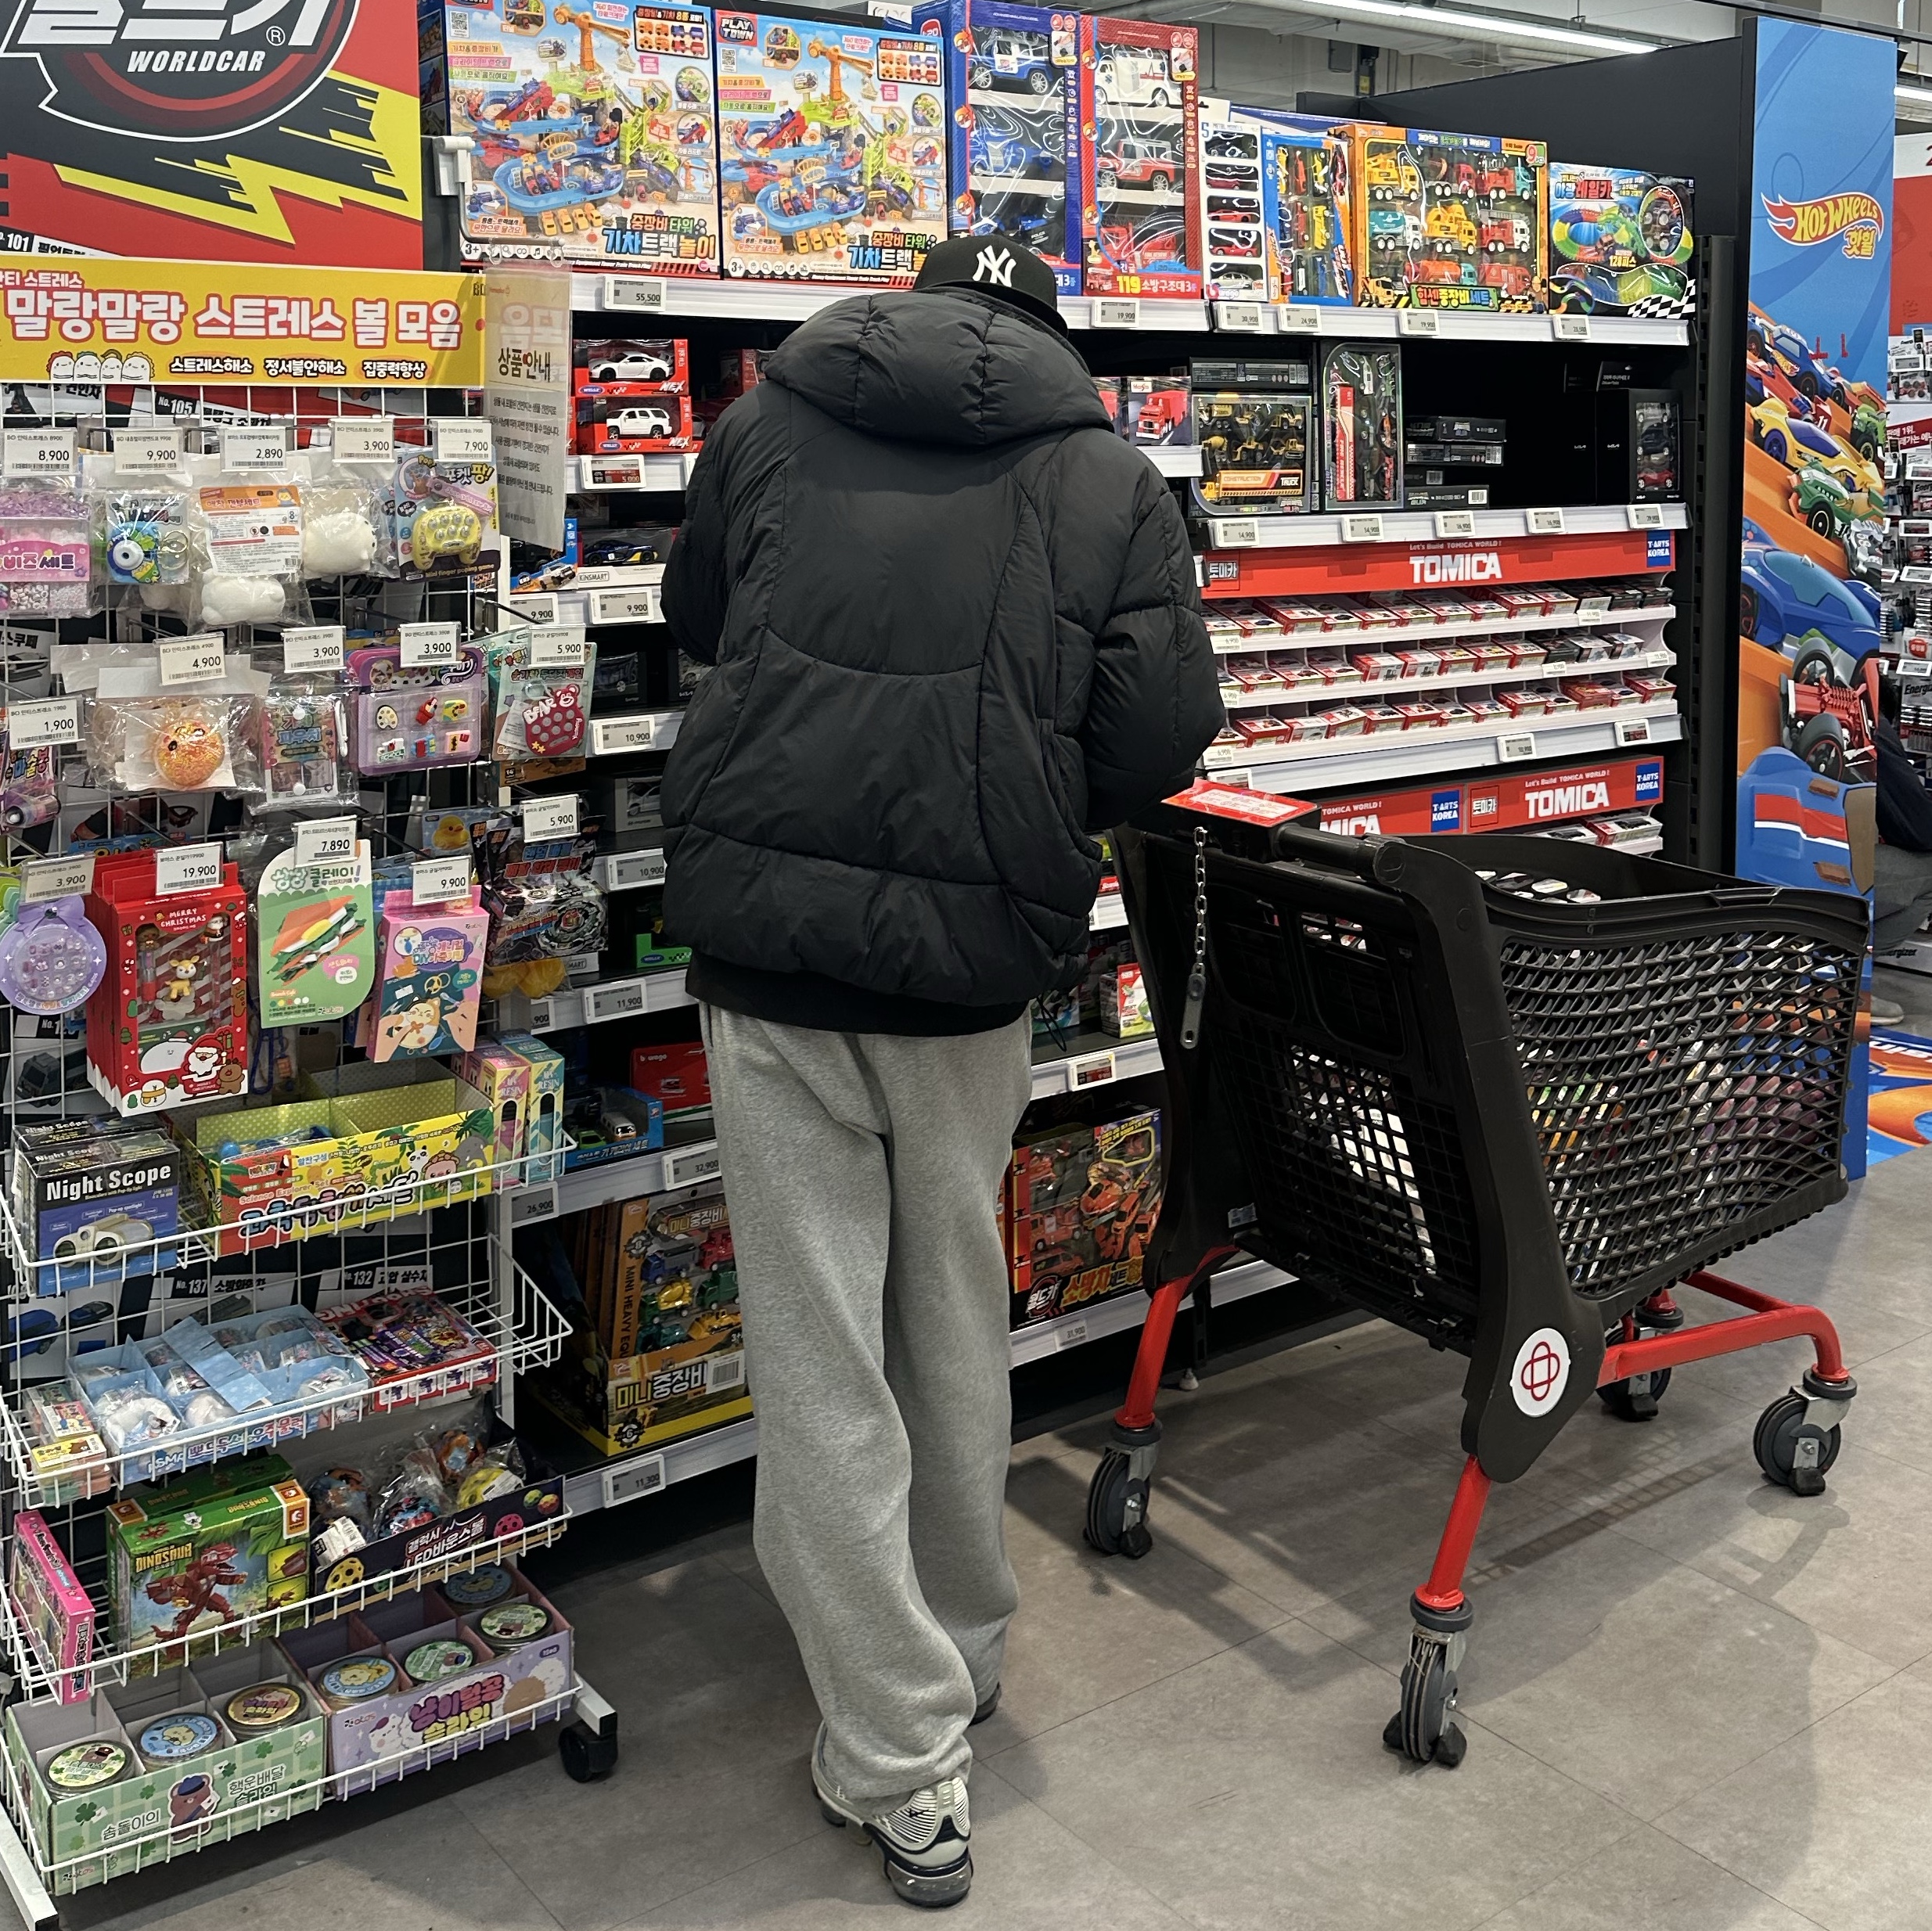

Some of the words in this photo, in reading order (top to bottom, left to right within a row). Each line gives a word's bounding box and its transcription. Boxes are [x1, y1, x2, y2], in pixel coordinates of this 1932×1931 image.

[721, 18, 751, 30] PLAY
[723, 28, 754, 41] TOWN
[127, 50, 265, 73] WORLDCAR
[7, 233, 30, 252] 101
[1848, 228, 1875, 257] 핫휠
[731, 261, 744, 271] 3+
[972, 245, 1016, 286] NY
[24, 271, 83, 289] 스트레스
[1117, 275, 1141, 293] 119
[636, 293, 660, 302] 55,500
[6, 290, 186, 342] 말랑말랑
[196, 294, 346, 341] 스트레스
[354, 299, 389, 348] 볼
[395, 301, 463, 351] 모음
[169, 356, 253, 376] 스트레스해소
[264, 357, 346, 377] 정서불안해소
[362, 359, 426, 379] 집중력향상
[660, 380, 684, 393] NEX
[158, 396, 171, 408] No.
[171, 399, 192, 416] 105
[363, 440, 389, 452] 3,900
[464, 441, 488, 452] 7,900
[669, 436, 689, 448] NEX
[38, 450, 70, 462] 8,900
[146, 450, 176, 463] 9,900
[256, 448, 282, 460] 2,890
[1648, 548, 1670, 557] KOREA
[1209, 563, 1236, 578] 토미카
[1409, 552, 1502, 584] TOMICA
[627, 603, 647, 613] 9,900
[531, 610, 552, 620] 9,900
[314, 645, 340, 658] 3,900
[424, 642, 452, 654] 3,900
[557, 644, 581, 655] 5,900
[192, 656, 221, 669] 4,900
[523, 697, 556, 725] BEAR
[44, 718, 74, 732] 1,900
[626, 732, 650, 743] 10,900
[1560, 773, 1583, 782] TOMICA
[1636, 781, 1659, 792] KOREA
[1525, 782, 1610, 819] TOMICA
[1322, 806, 1351, 816] TOMICA
[1433, 811, 1459, 822] KOREA
[550, 814, 574, 827] 5,900
[321, 840, 350, 853] 7,890
[182, 865, 217, 879] 19,900
[640, 868, 664, 878] 10,900
[56, 875, 86, 887] 3,900
[441, 877, 466, 889] 9,900
[169, 908, 197, 919] MERRY
[160, 914, 207, 929] CHRISTMAS
[617, 997, 642, 1009] 11,900
[538, 1079, 559, 1091] RESIN
[695, 1160, 718, 1173] 32,900
[46, 1175, 103, 1202] Night
[109, 1164, 172, 1191] Scope
[239, 1192, 274, 1205] Science
[275, 1182, 315, 1199] Explorer
[527, 1201, 552, 1214] 26,900
[353, 1269, 373, 1286] 132
[188, 1279, 208, 1295] 137
[135, 1543, 192, 1574] DINOSAUR
[228, 1764, 286, 1799] 행운배달
[102, 1809, 161, 1843] 솜돌이의
